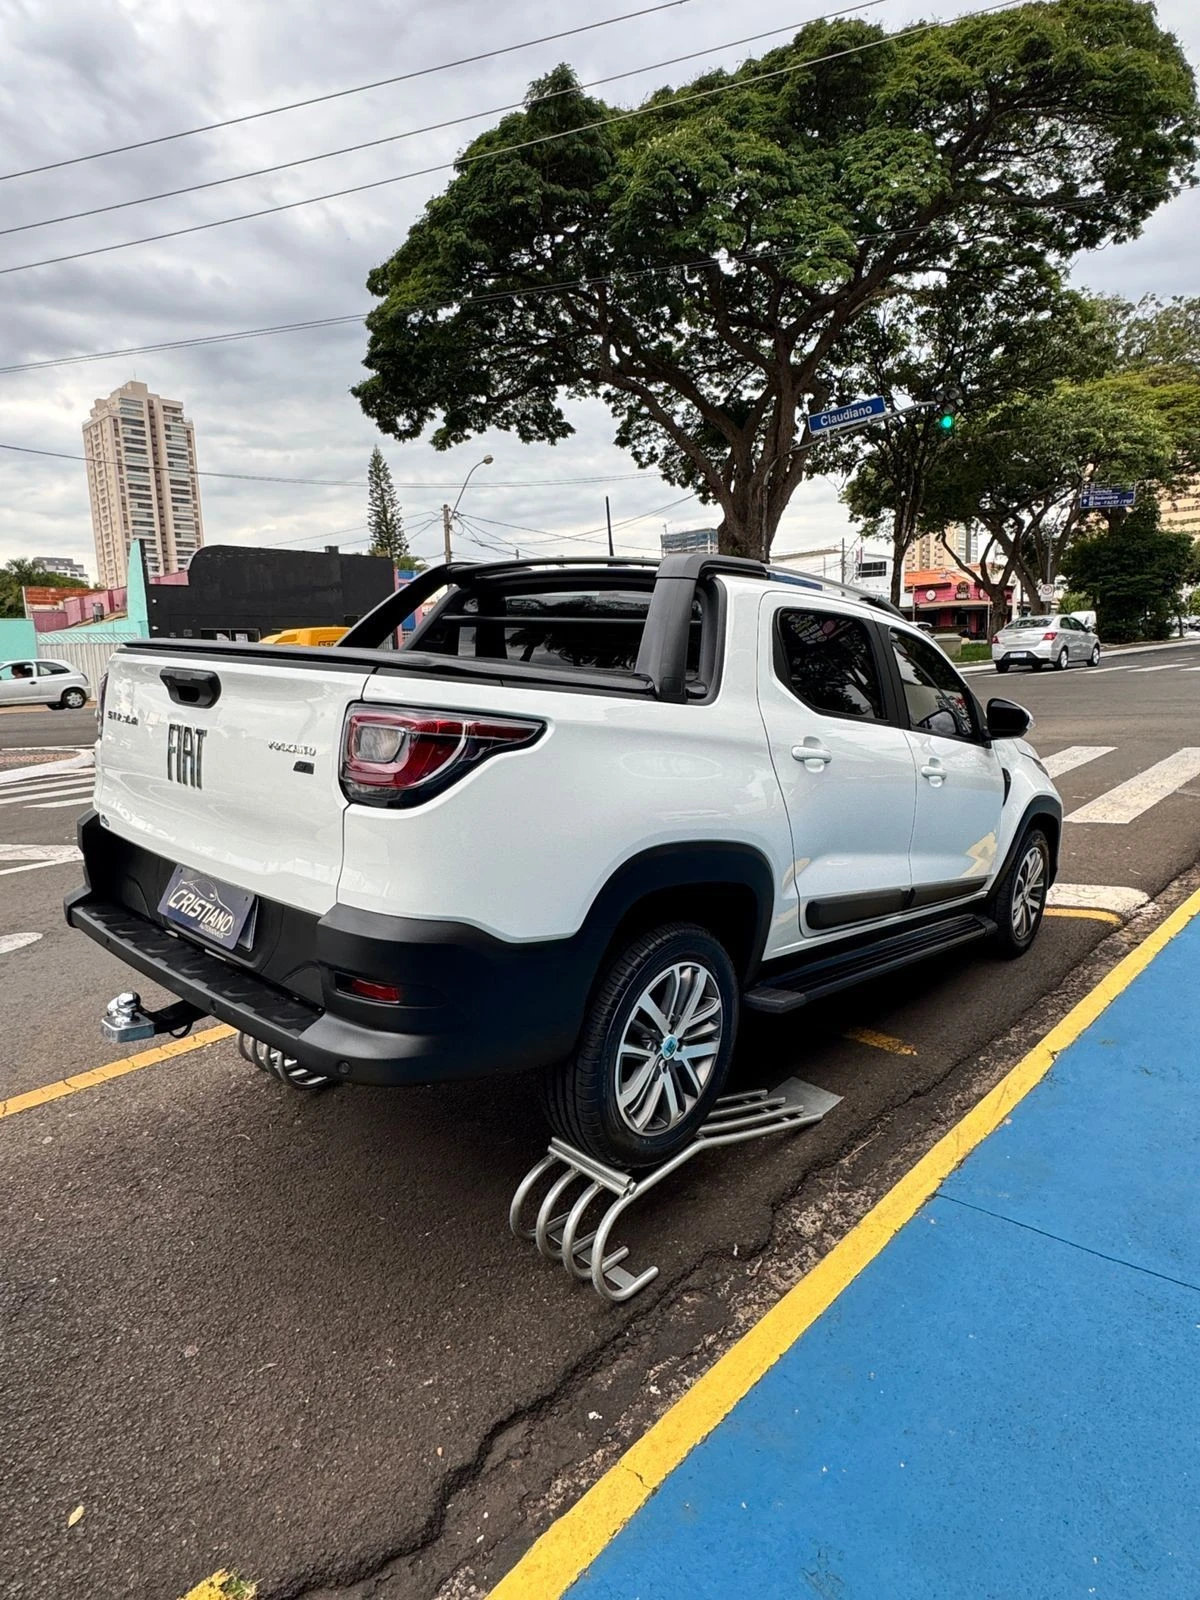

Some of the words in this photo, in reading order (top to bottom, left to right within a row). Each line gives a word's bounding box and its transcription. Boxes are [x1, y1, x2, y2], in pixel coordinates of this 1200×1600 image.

[820, 406, 873, 426] Claudiano
[167, 723, 208, 791] FIAT
[168, 889, 233, 932] CRISTIANO
